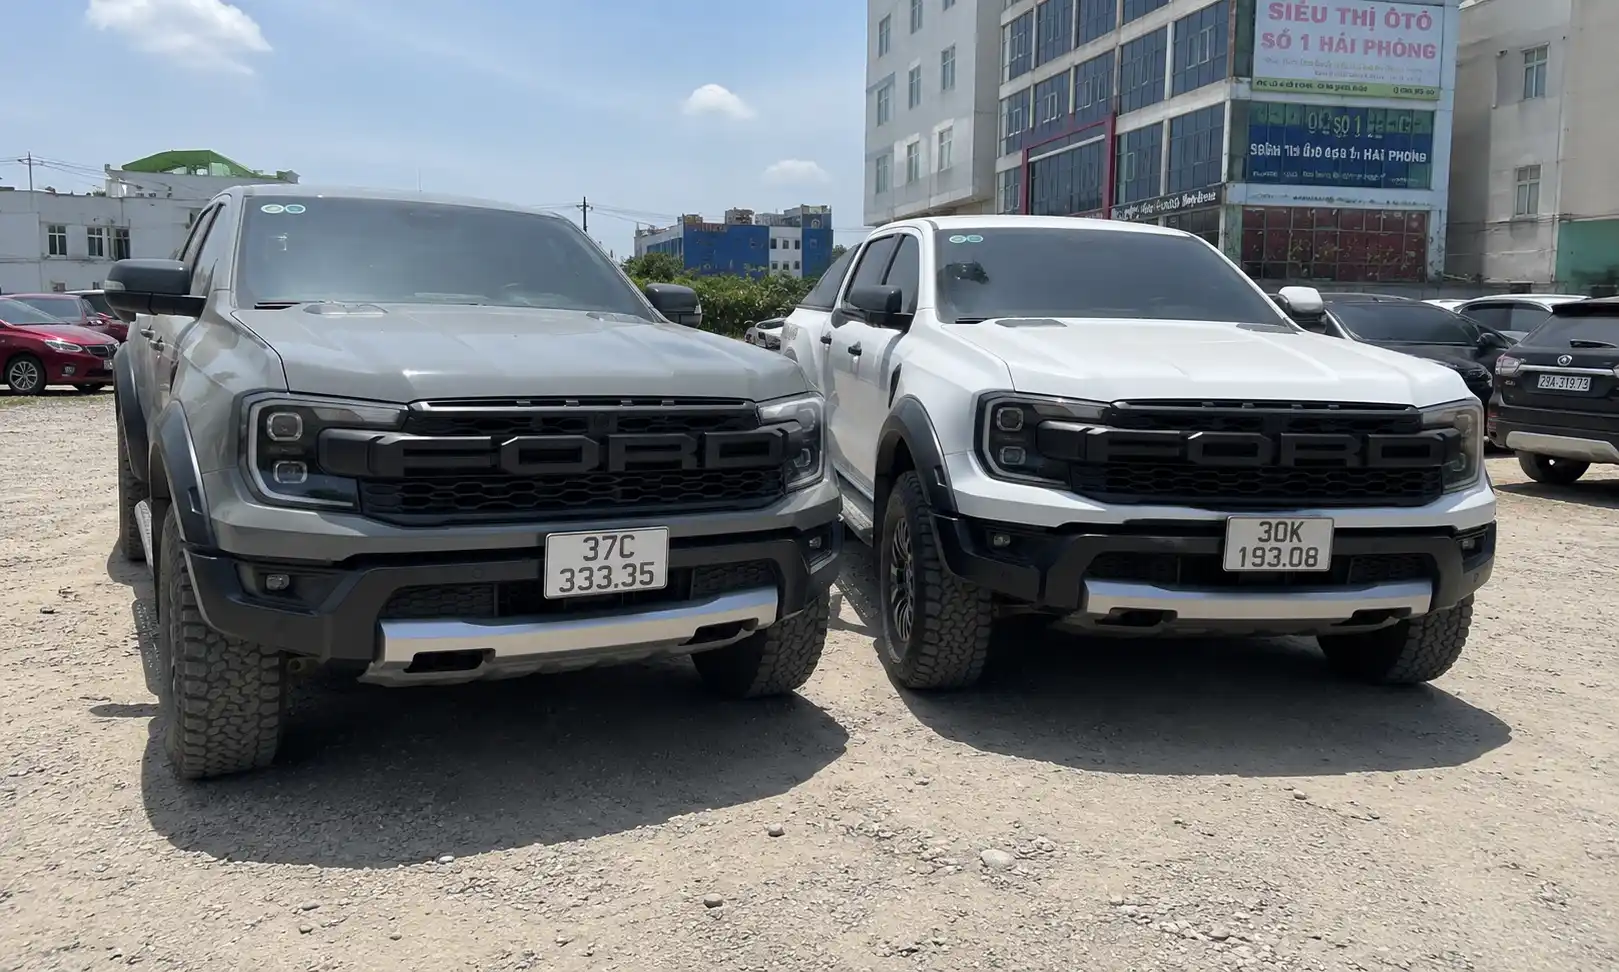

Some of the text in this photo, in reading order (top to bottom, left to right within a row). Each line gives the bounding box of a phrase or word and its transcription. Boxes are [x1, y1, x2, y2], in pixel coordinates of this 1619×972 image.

[1301, 33, 1310, 51] 1
[374, 428, 787, 477] FORD
[1086, 426, 1446, 469] FORD
[1257, 520, 1304, 543] 30K
[582, 533, 635, 561] 37C
[1238, 546, 1319, 568] 193.08
[558, 561, 655, 593] 333.35
